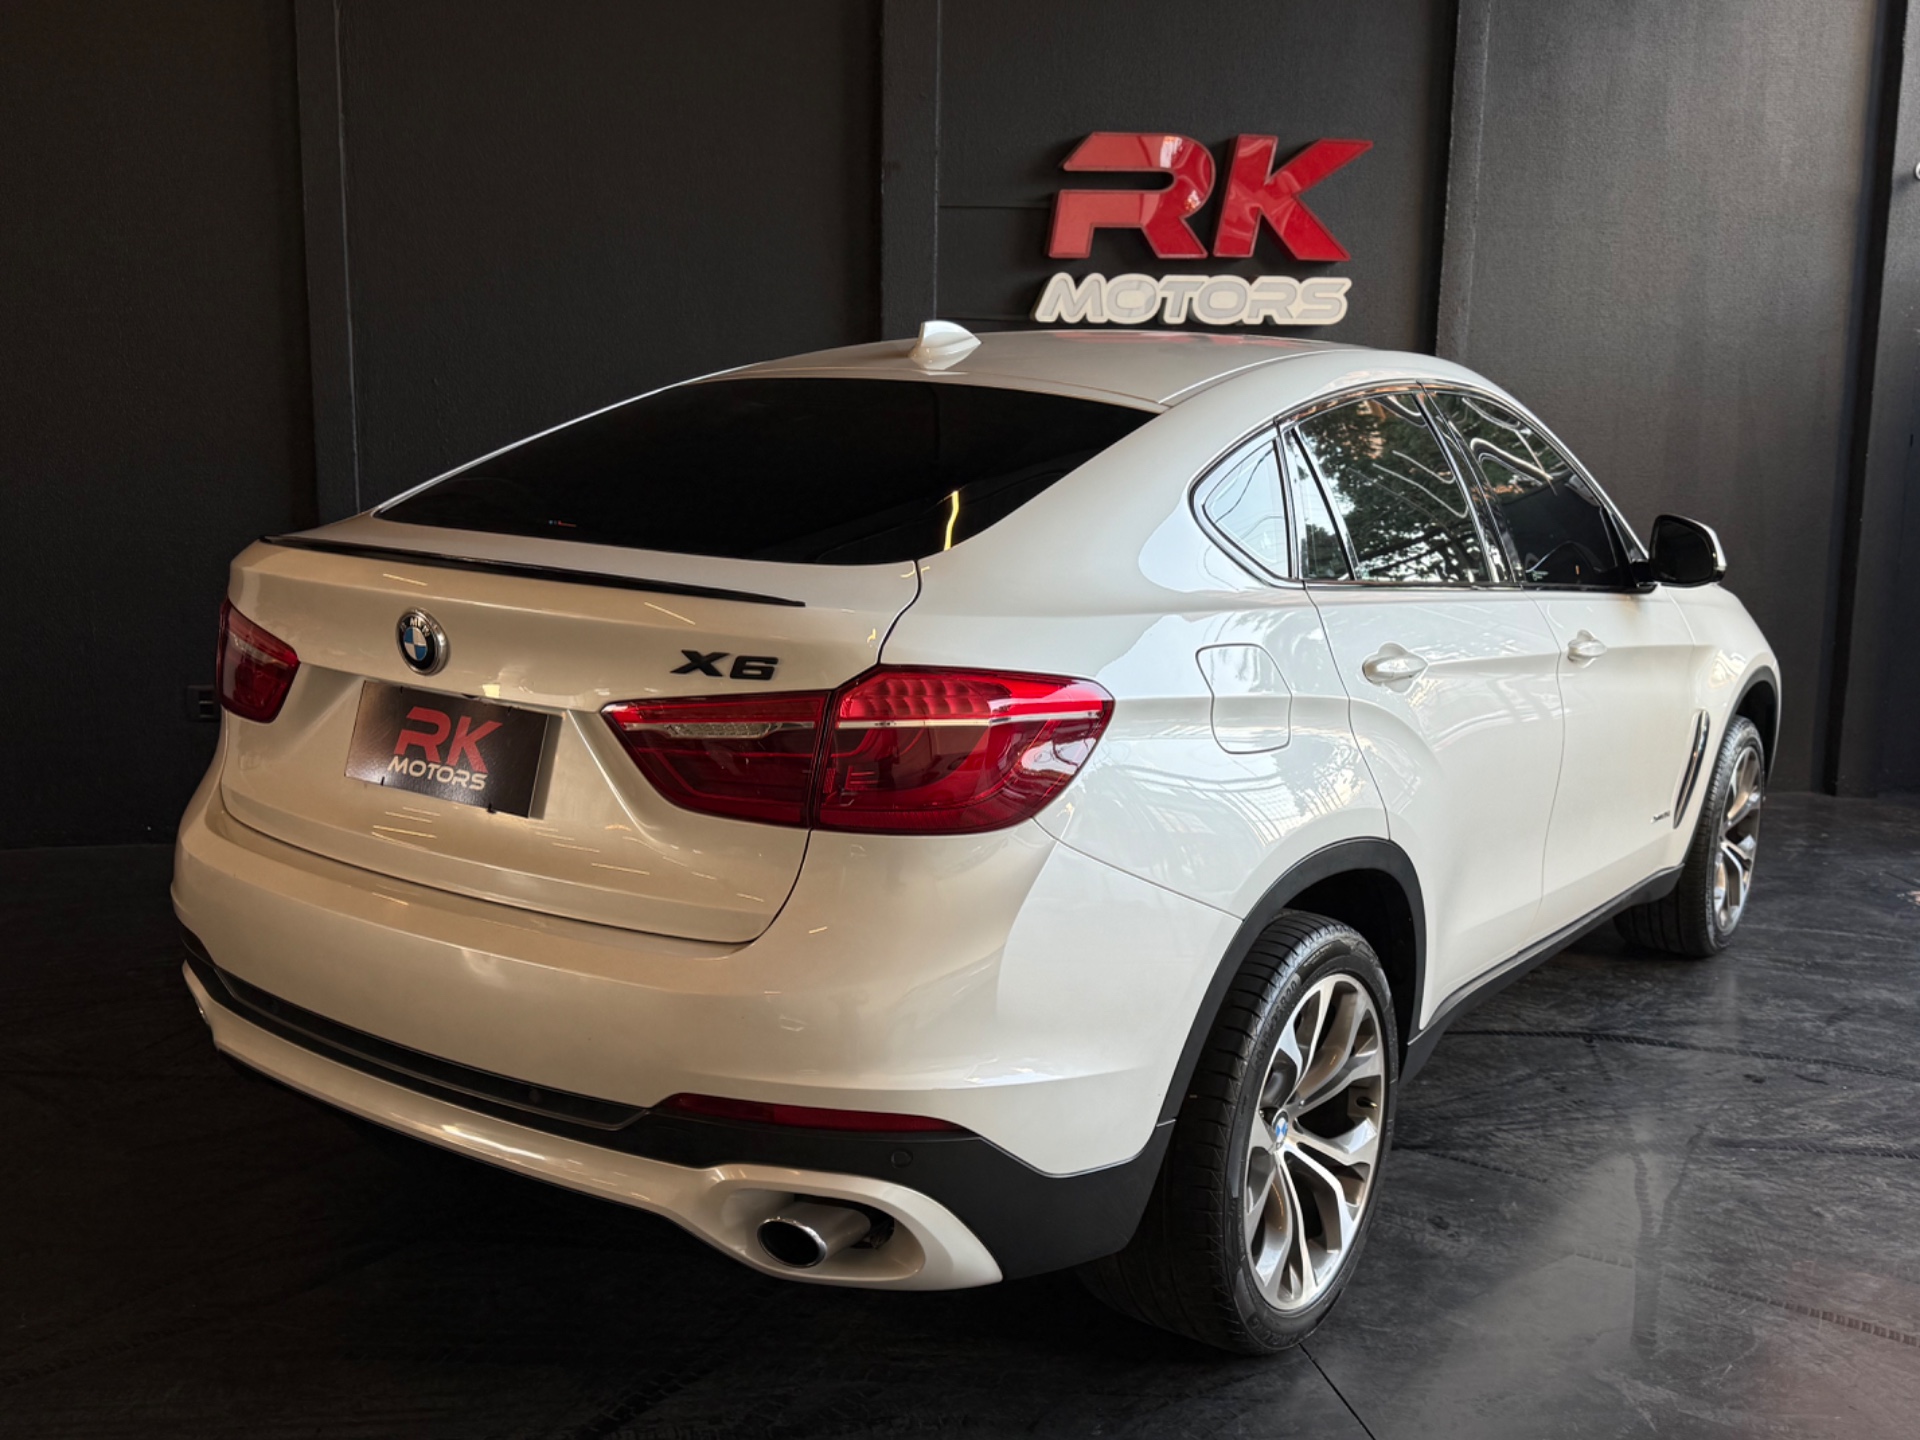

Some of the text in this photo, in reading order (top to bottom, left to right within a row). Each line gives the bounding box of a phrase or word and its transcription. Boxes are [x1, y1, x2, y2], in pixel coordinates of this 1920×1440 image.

[1049, 131, 1374, 261] RK
[1034, 272, 1352, 325] MOTORS
[669, 649, 779, 681] X6
[393, 706, 503, 774] RK
[387, 755, 488, 791] MOTORS
